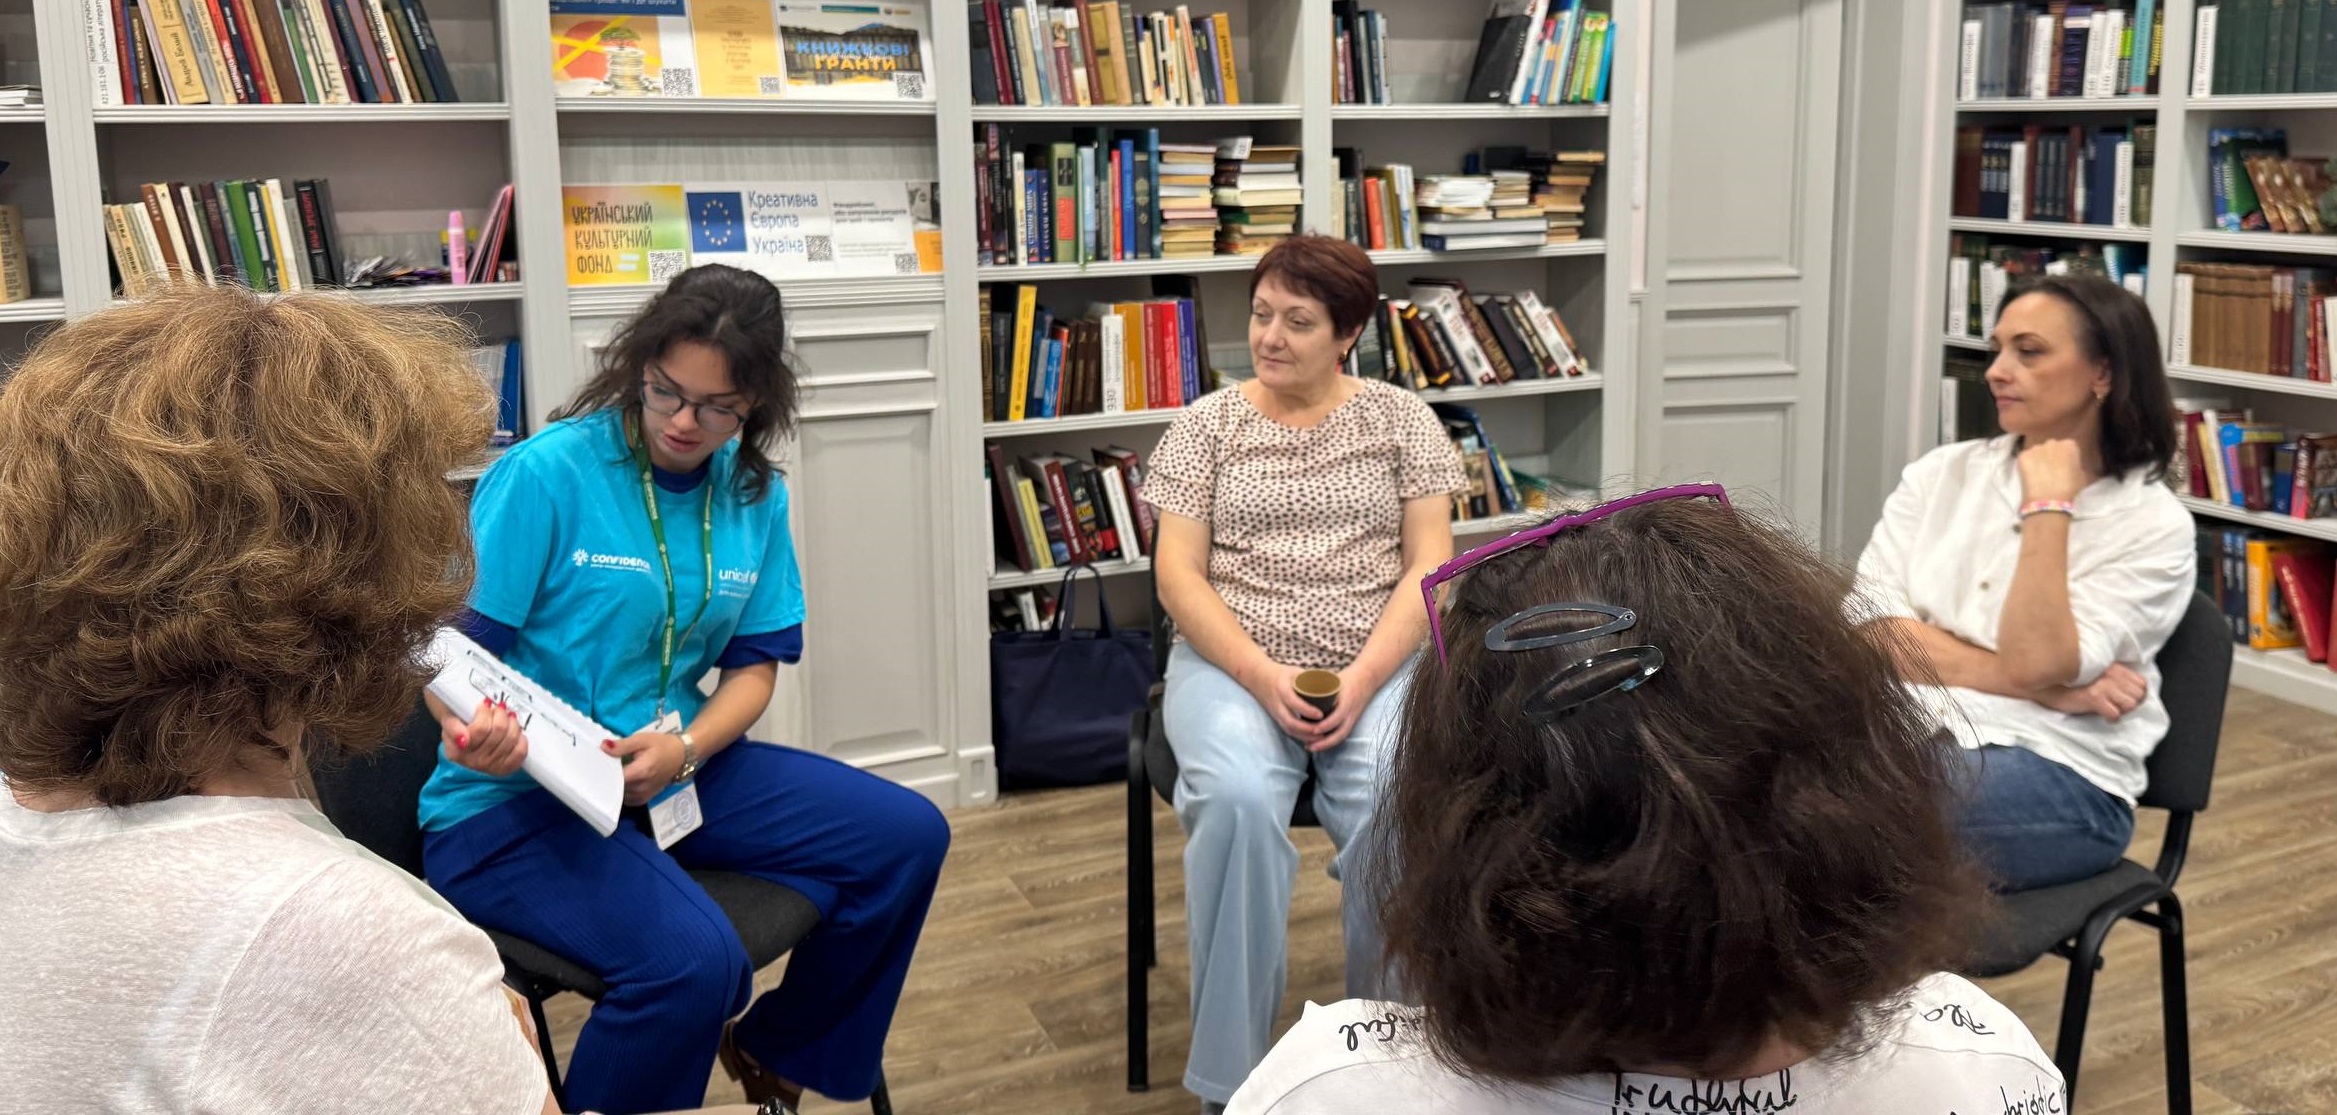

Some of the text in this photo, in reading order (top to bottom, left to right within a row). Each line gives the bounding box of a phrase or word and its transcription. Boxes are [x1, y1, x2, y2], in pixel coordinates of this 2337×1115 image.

[796, 42, 910, 56] КНИЖКОВІ
[814, 56, 898, 71] ГРАНТИ
[748, 191, 818, 210] Креативна
[572, 202, 653, 225] УКРАЇНСЬКИЙ
[750, 212, 799, 230] Європа
[575, 228, 653, 250] КУЛЬТУРНИЙ
[753, 236, 804, 256] Україна
[577, 255, 613, 275] ФОНД
[718, 567, 751, 584] unicef
